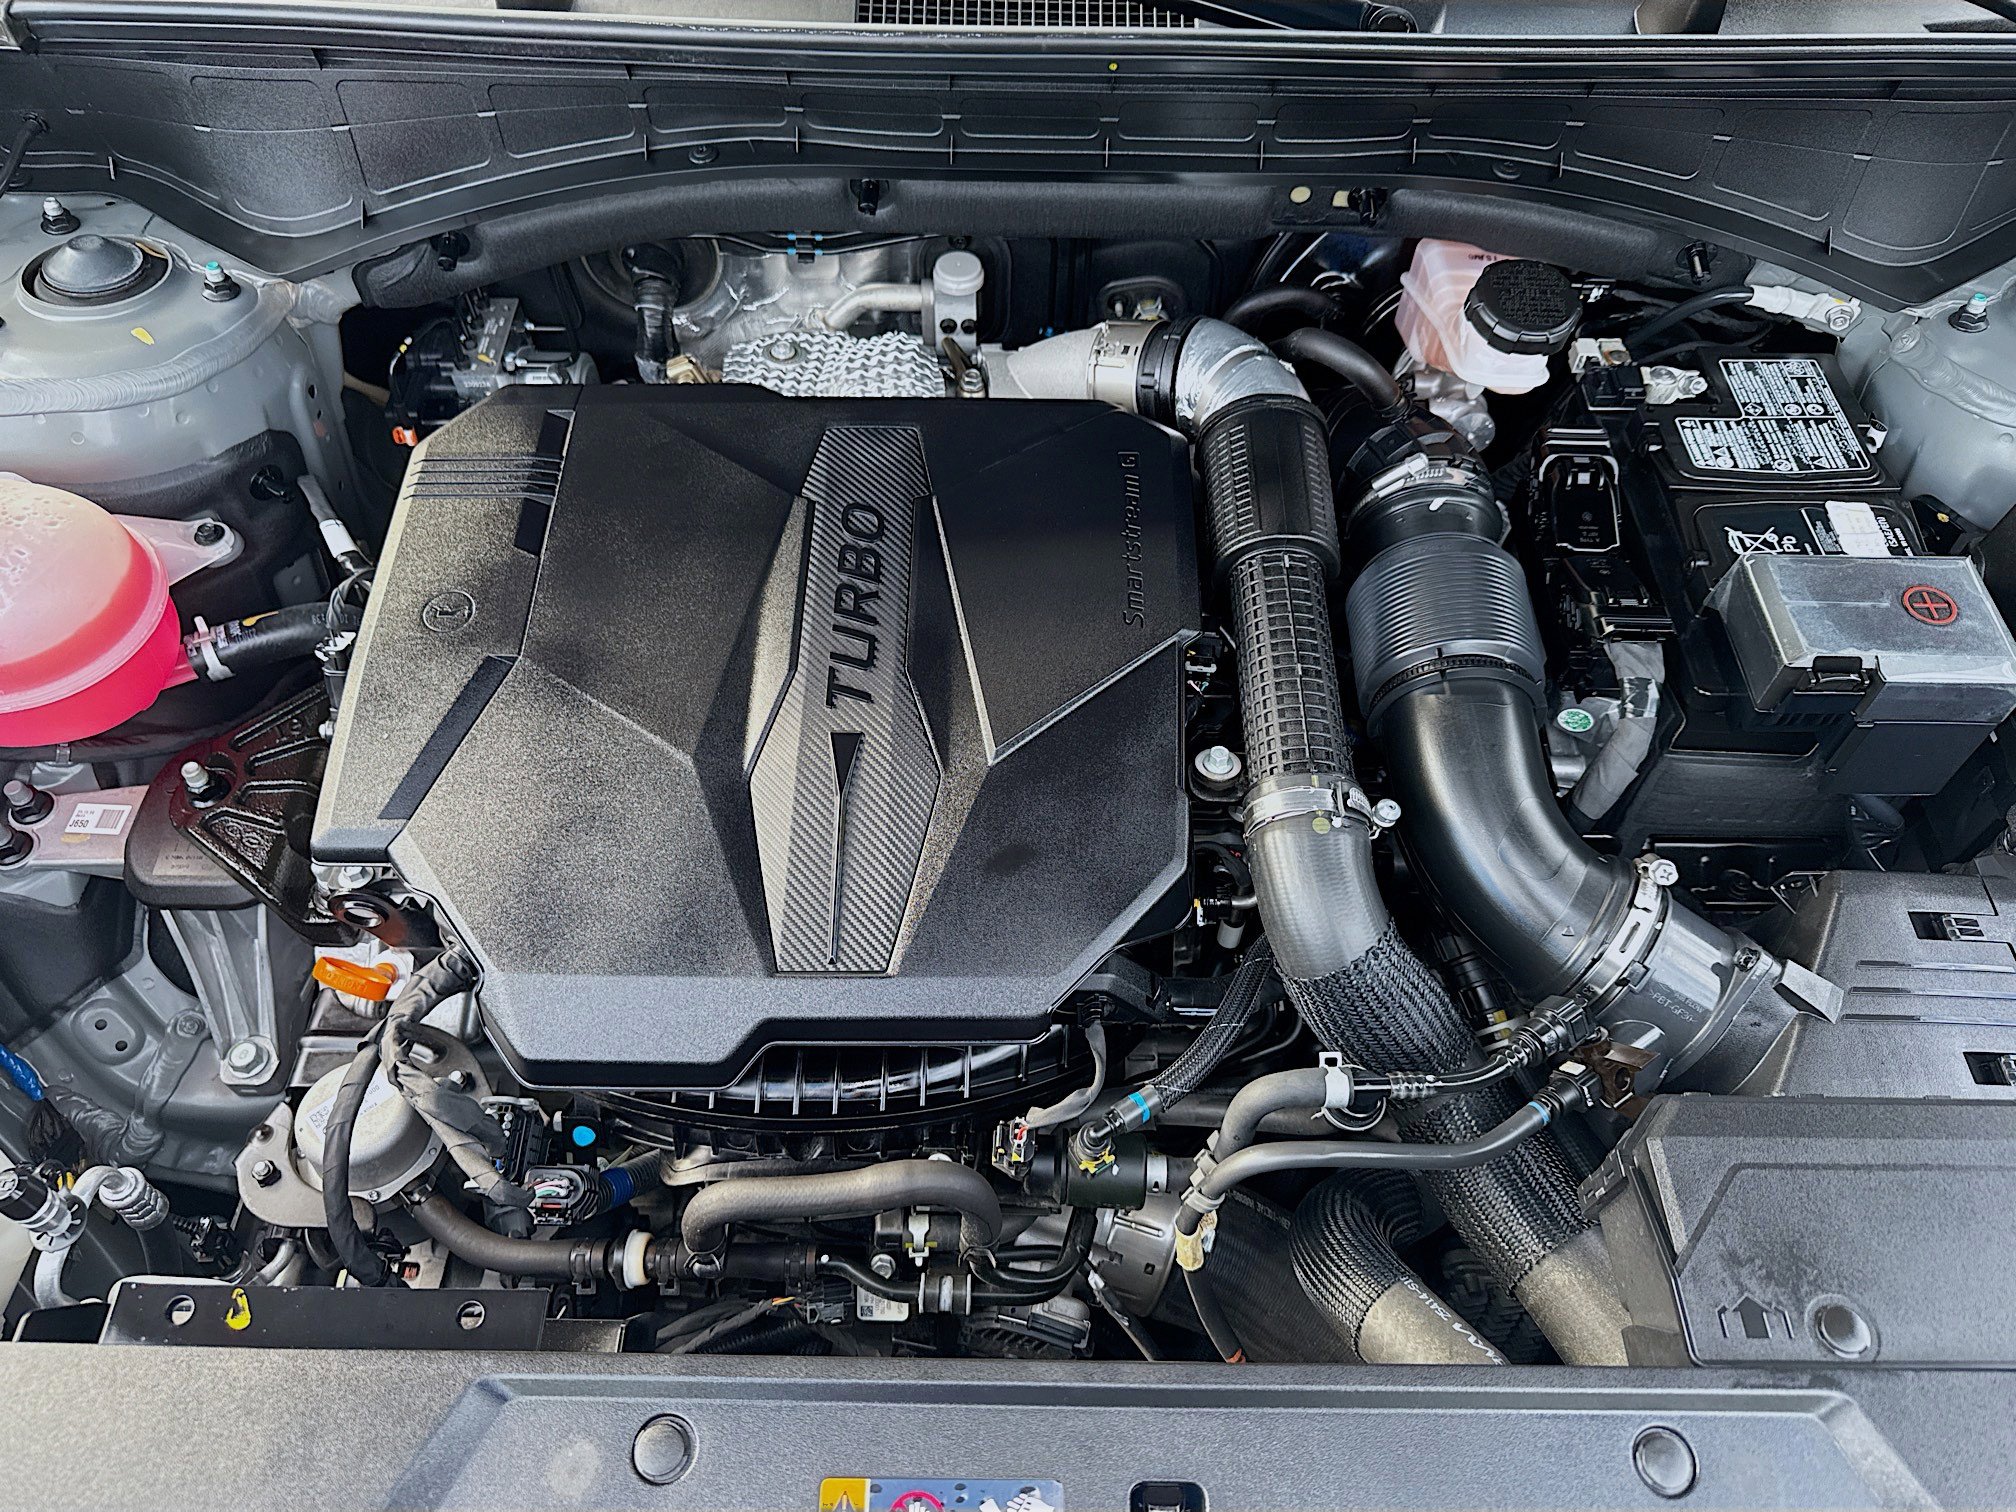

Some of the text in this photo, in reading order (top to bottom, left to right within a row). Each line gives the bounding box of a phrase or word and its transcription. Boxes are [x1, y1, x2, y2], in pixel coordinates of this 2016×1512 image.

[1121, 474, 1145, 629] Smartstream
[1783, 535, 1801, 553] Pb
[826, 502, 885, 710] TURBO
[69, 819, 89, 828] J650
